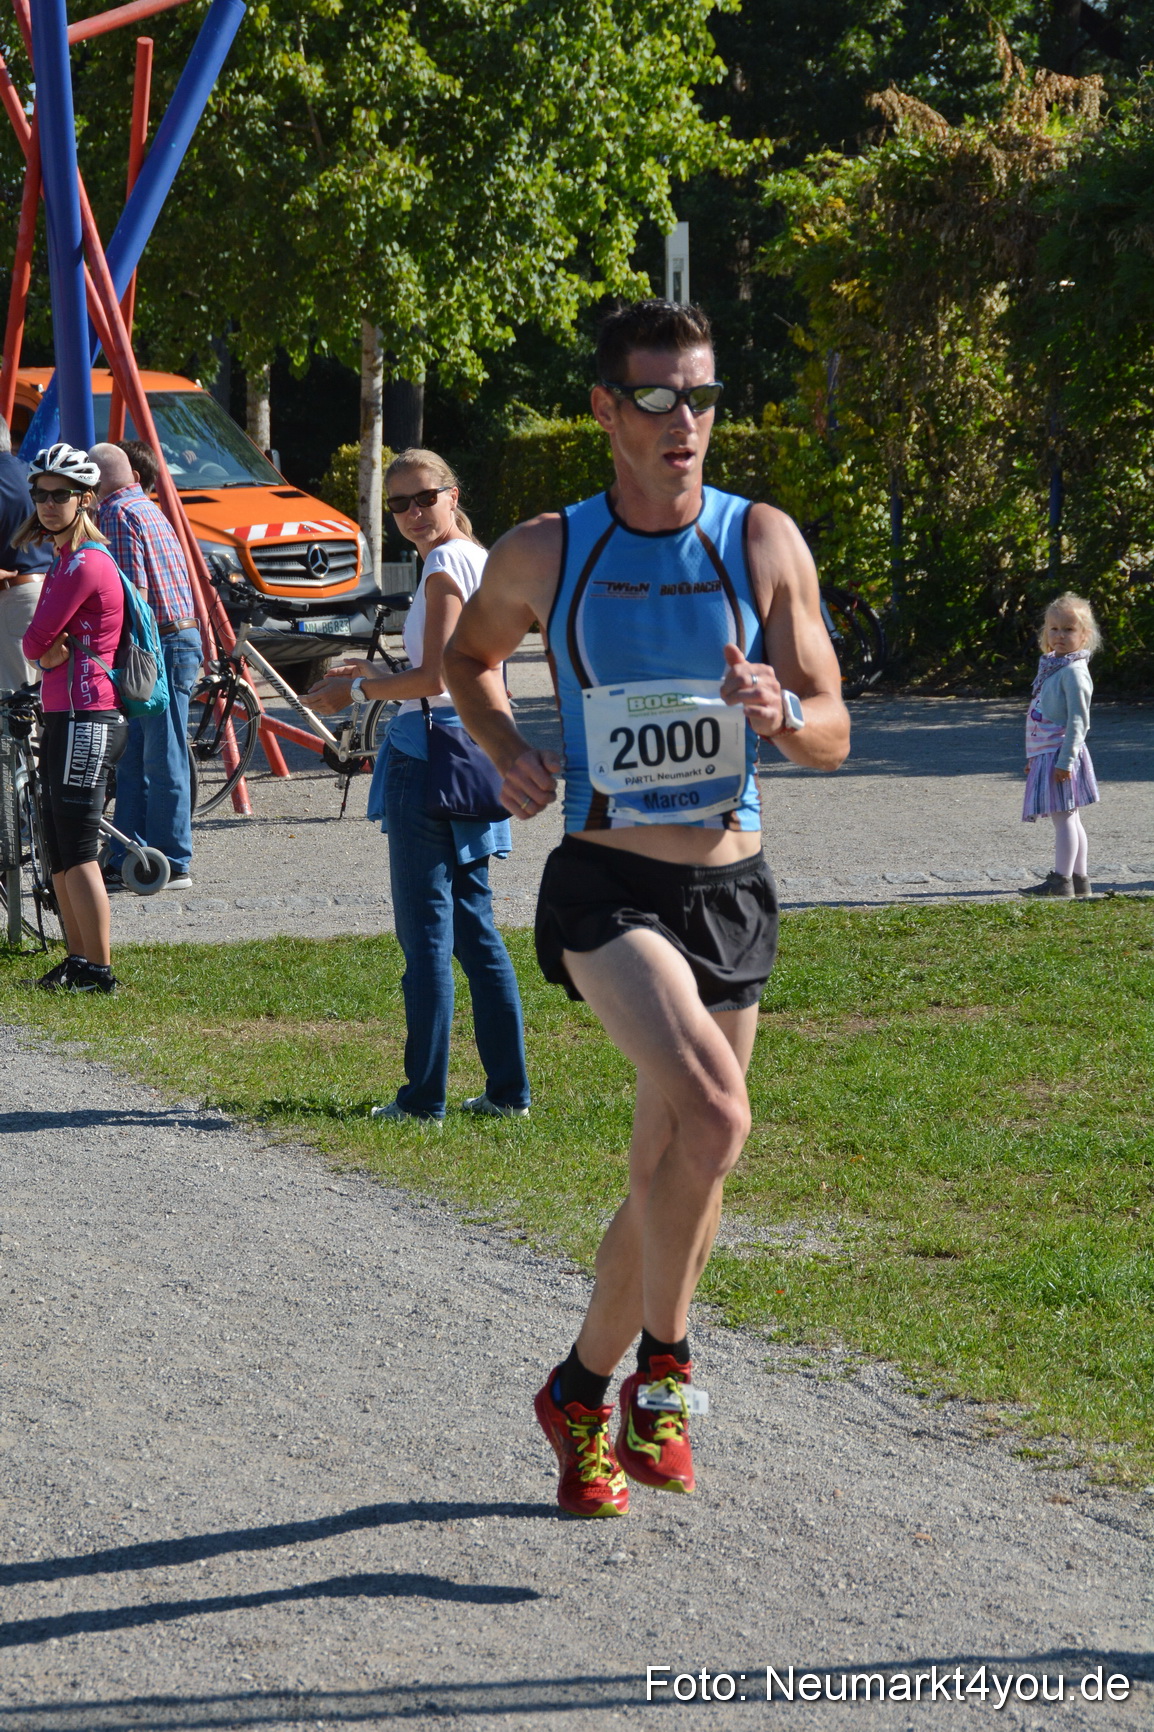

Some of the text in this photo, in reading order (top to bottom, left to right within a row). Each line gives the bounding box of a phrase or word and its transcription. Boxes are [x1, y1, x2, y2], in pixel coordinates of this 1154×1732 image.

[627, 692, 698, 712] BOCK
[69, 721, 93, 787] LA CARRERA
[83, 756, 98, 787] TRITEAM
[91, 722, 102, 756] ROTHSEE
[609, 716, 721, 771] 2000
[625, 769, 702, 786] PARTL Neumarkt
[643, 790, 700, 810] Marco
